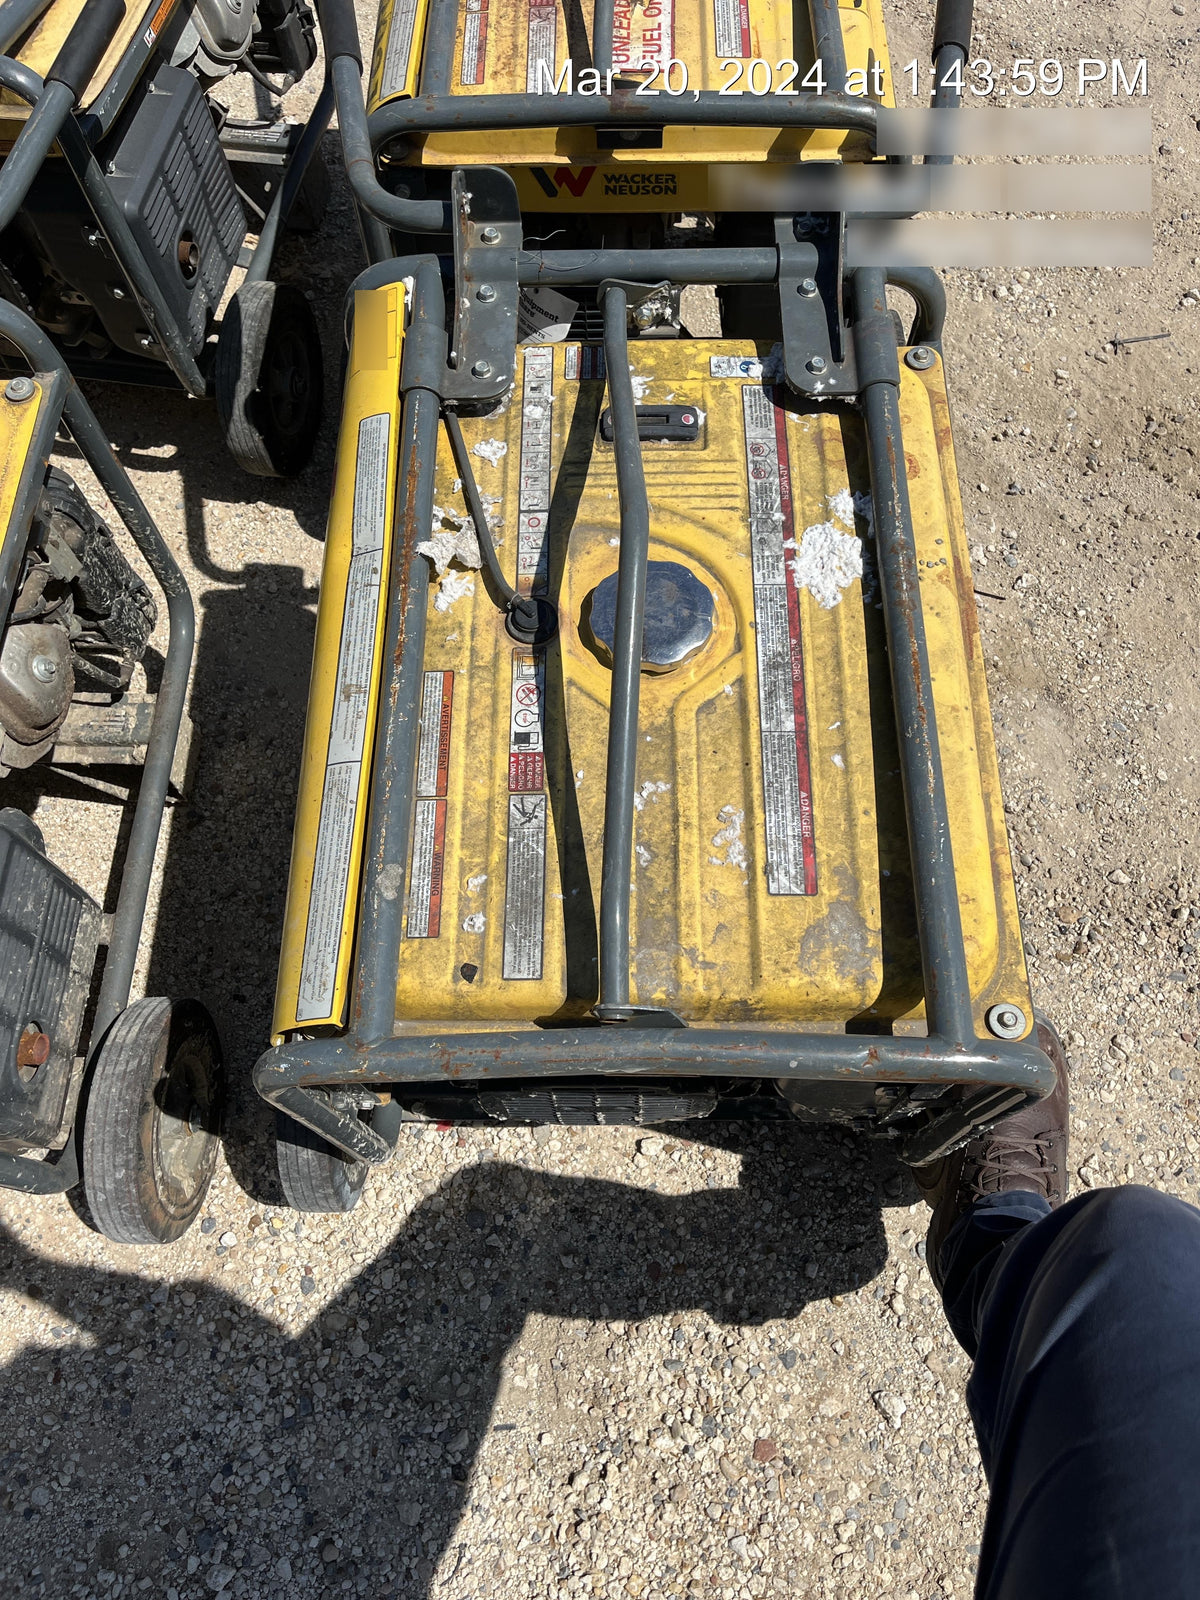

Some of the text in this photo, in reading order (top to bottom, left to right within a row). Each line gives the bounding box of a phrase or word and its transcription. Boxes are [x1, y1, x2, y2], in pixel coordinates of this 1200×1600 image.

[603, 173, 677, 184] WACKER
[604, 184, 677, 195] NEUSON
[438, 703, 450, 771] AVERTISSEMENT
[801, 799, 811, 838] DANGER
[431, 852, 442, 896] WARNING
